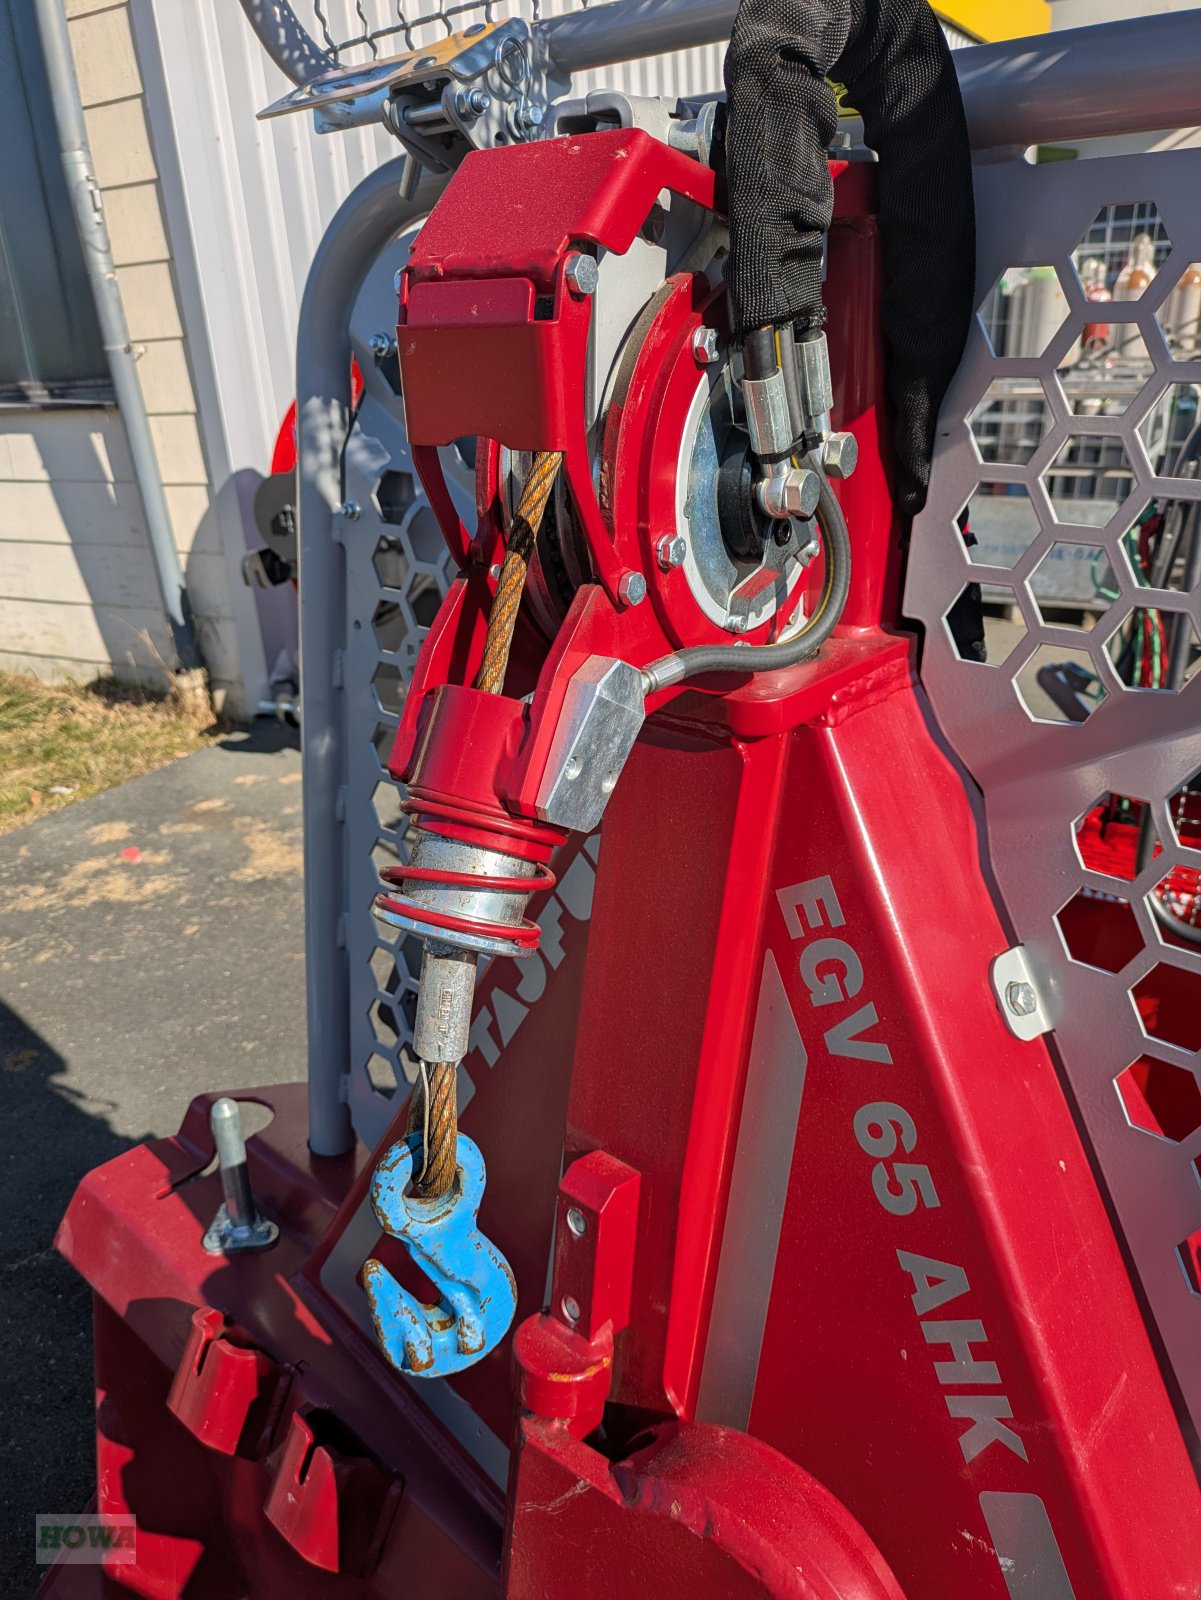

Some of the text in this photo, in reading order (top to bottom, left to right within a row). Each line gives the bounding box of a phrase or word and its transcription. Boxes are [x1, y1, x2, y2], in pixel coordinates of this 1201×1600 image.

[469, 834, 601, 1069] TAJFU
[775, 874, 1029, 1464] EGV 65 AHK
